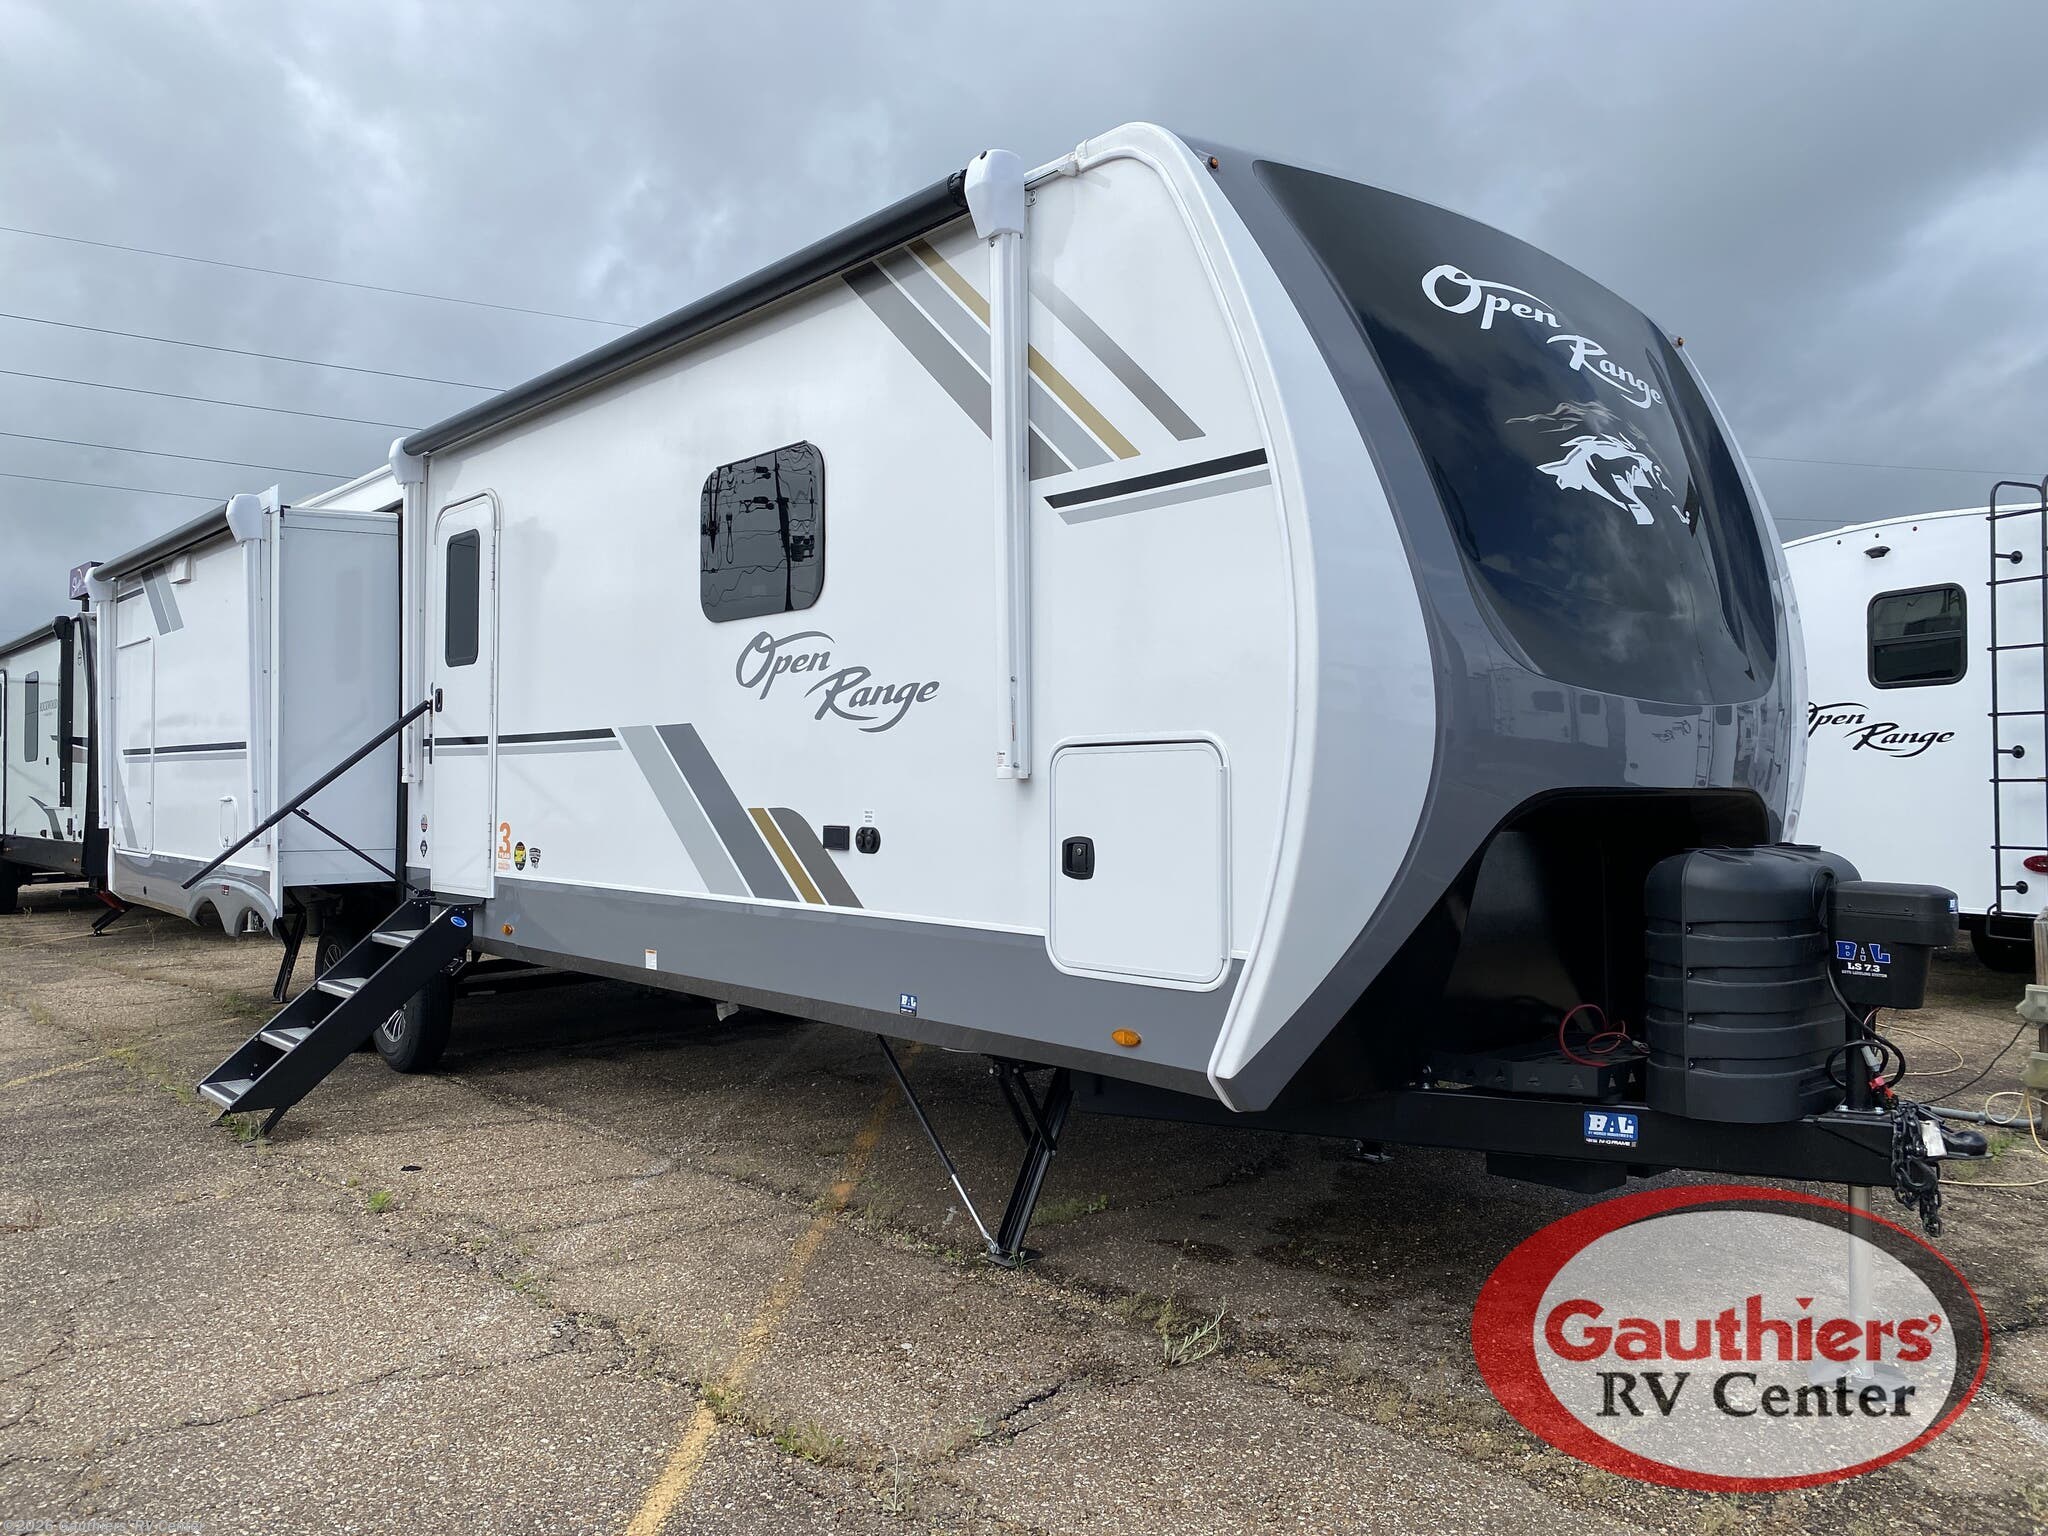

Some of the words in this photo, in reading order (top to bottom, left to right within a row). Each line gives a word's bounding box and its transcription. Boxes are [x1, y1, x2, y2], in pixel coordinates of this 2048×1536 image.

[1421, 264, 1562, 330] Open
[1546, 334, 1663, 409] Range
[735, 630, 836, 701] Open
[804, 666, 941, 733] Range
[1843, 722, 1955, 758] Range
[499, 822, 511, 853] 3
[1847, 962, 1862, 970] LS
[1588, 1114, 1634, 1134] BAL
